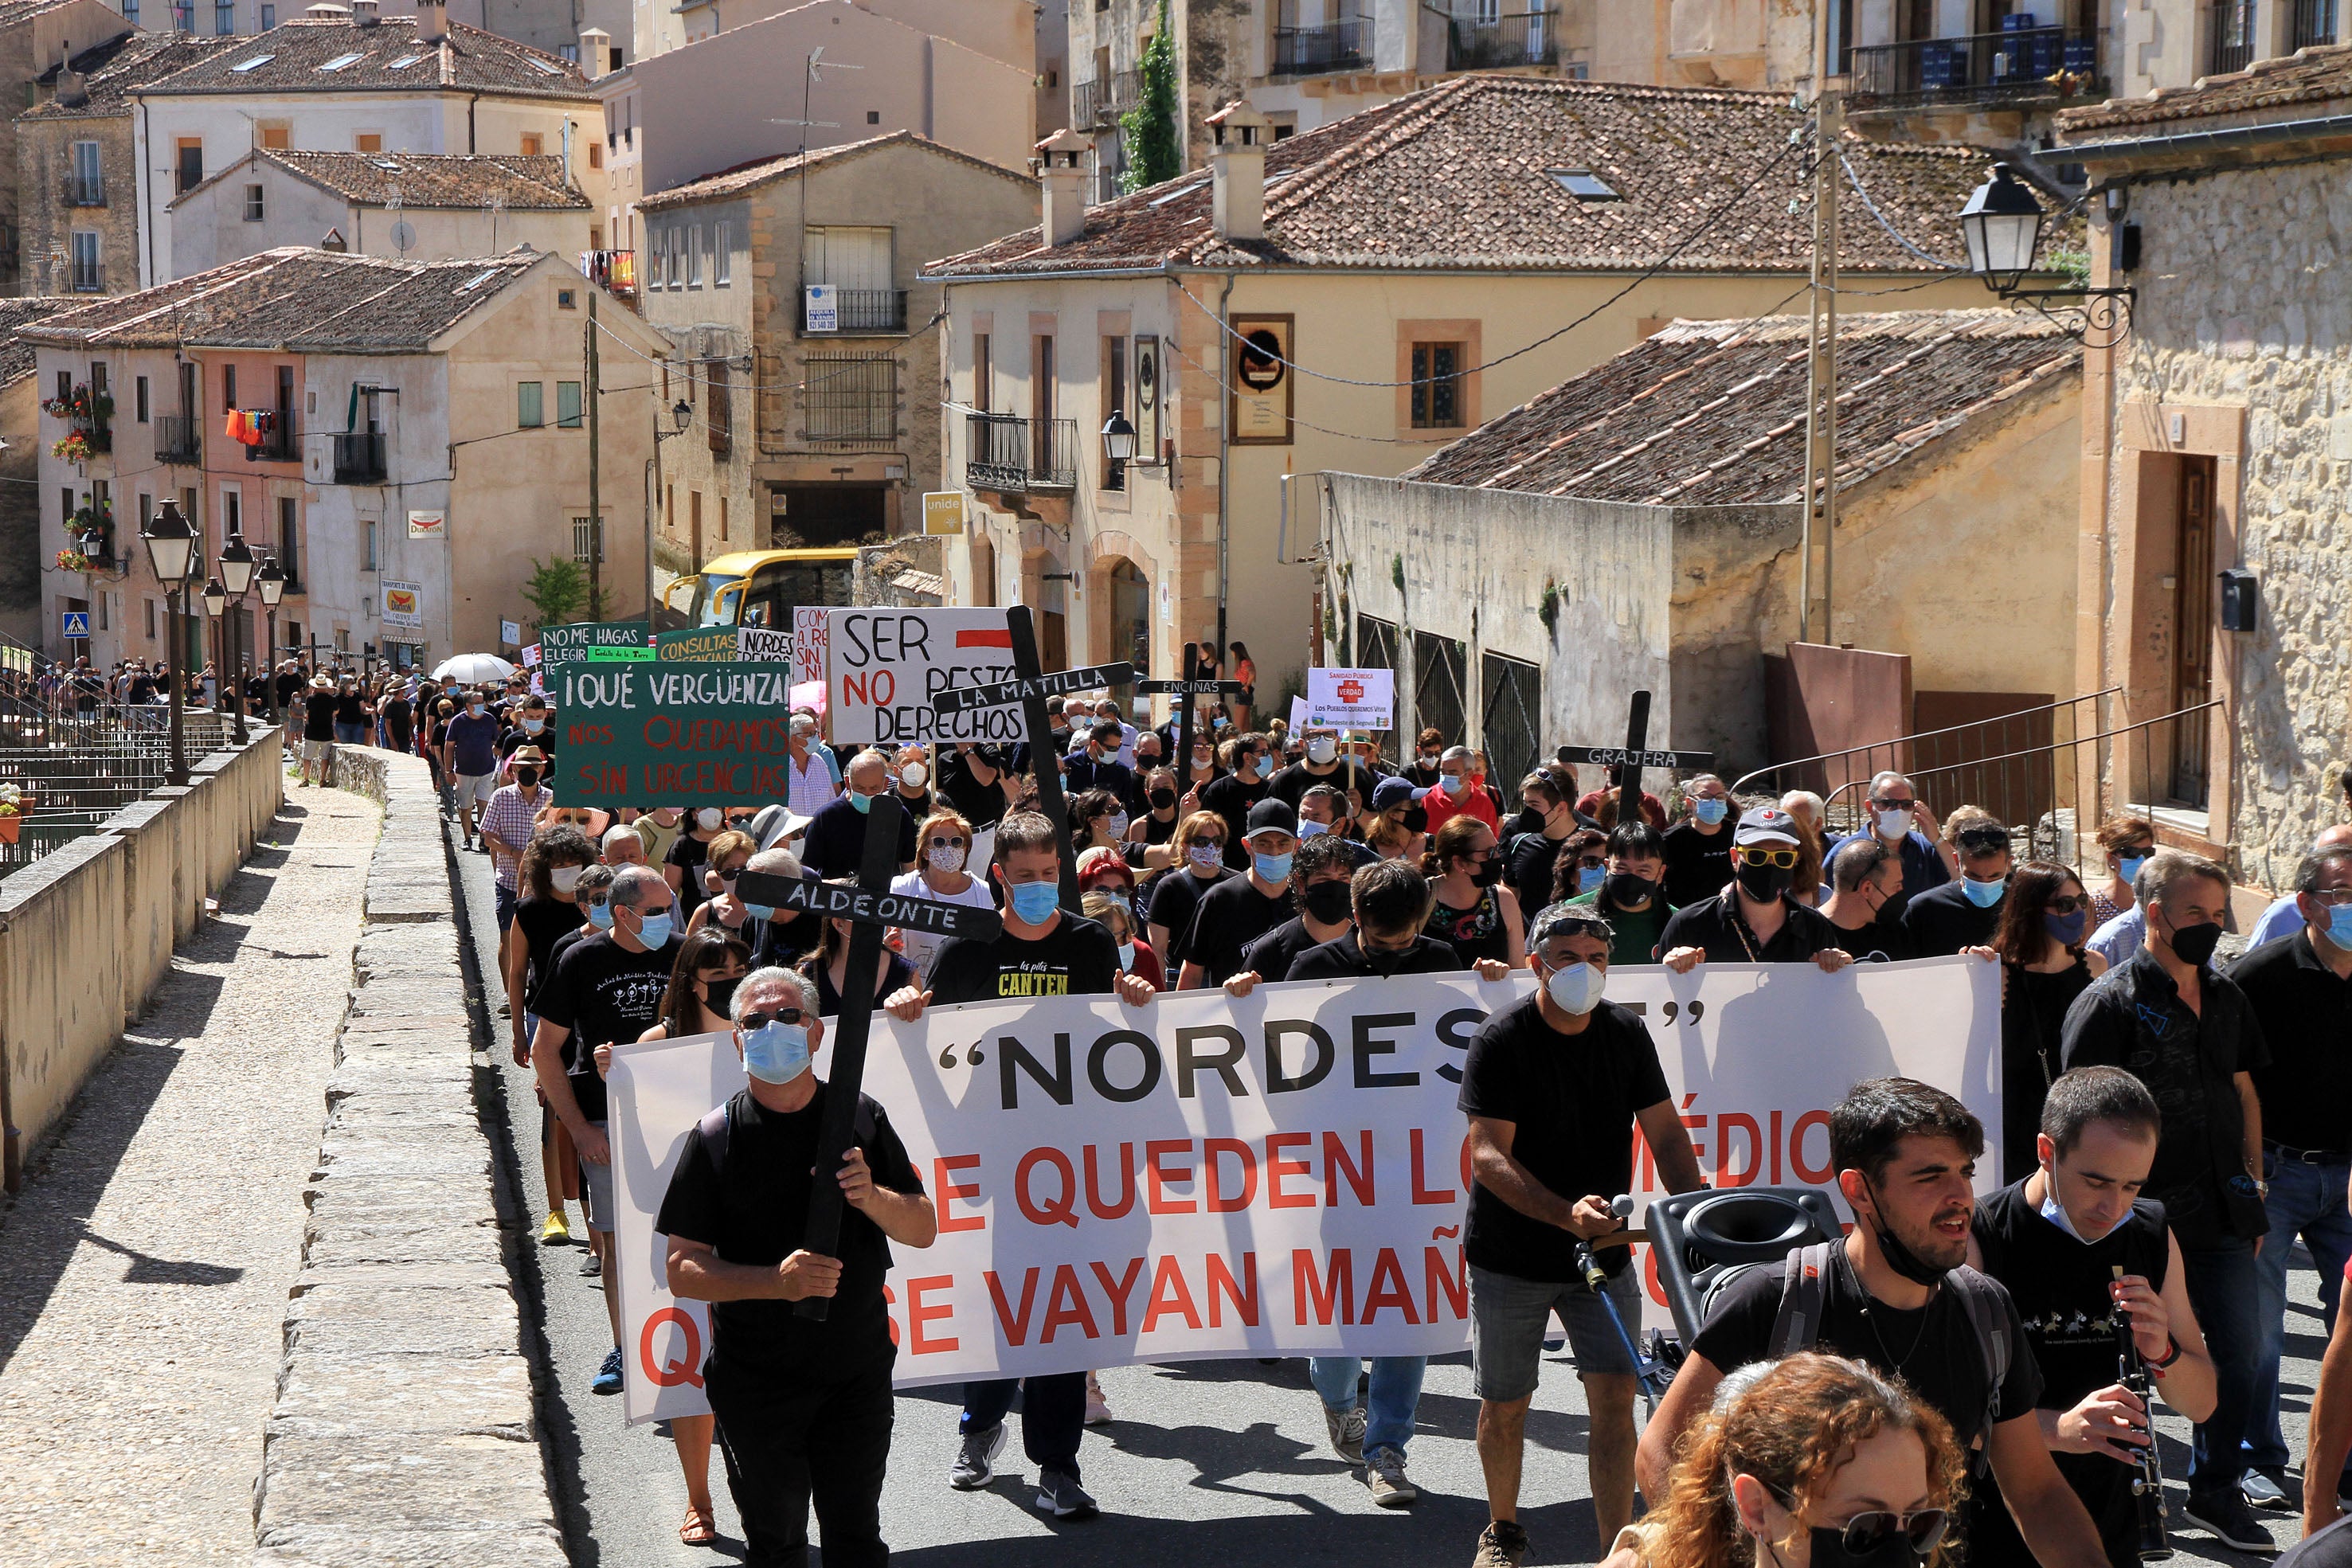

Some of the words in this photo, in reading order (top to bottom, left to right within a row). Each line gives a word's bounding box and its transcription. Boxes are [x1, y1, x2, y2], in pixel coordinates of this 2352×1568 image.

[928, 499, 959, 510] unide
[543, 629, 569, 647] NO
[571, 628, 589, 644] ME
[597, 628, 638, 644] HAGAS
[545, 646, 586, 662] ELEGIR
[660, 634, 738, 661] CONSULTAS
[843, 614, 930, 667] SER
[565, 664, 636, 709] ¡QUÉ
[843, 669, 895, 706] NO
[958, 689, 988, 708] LA
[1000, 670, 1106, 700] MATILLA
[1163, 681, 1219, 694] ENCINAS
[644, 715, 789, 756] QUEDAMOS
[875, 706, 1023, 742] DERECHOS
[578, 761, 628, 795] SIN
[644, 758, 786, 796] URGENCIAS
[1588, 749, 1677, 768] GRAJERA
[787, 883, 959, 929] ALDEONTE
[998, 973, 1068, 996] CANTEN
[1020, 960, 1030, 972] les
[939, 1000, 1704, 1109] “NORDES”
[912, 1153, 985, 1234] E
[1014, 1129, 1376, 1228] QUEDEN
[984, 1252, 1259, 1347] VAYAN
